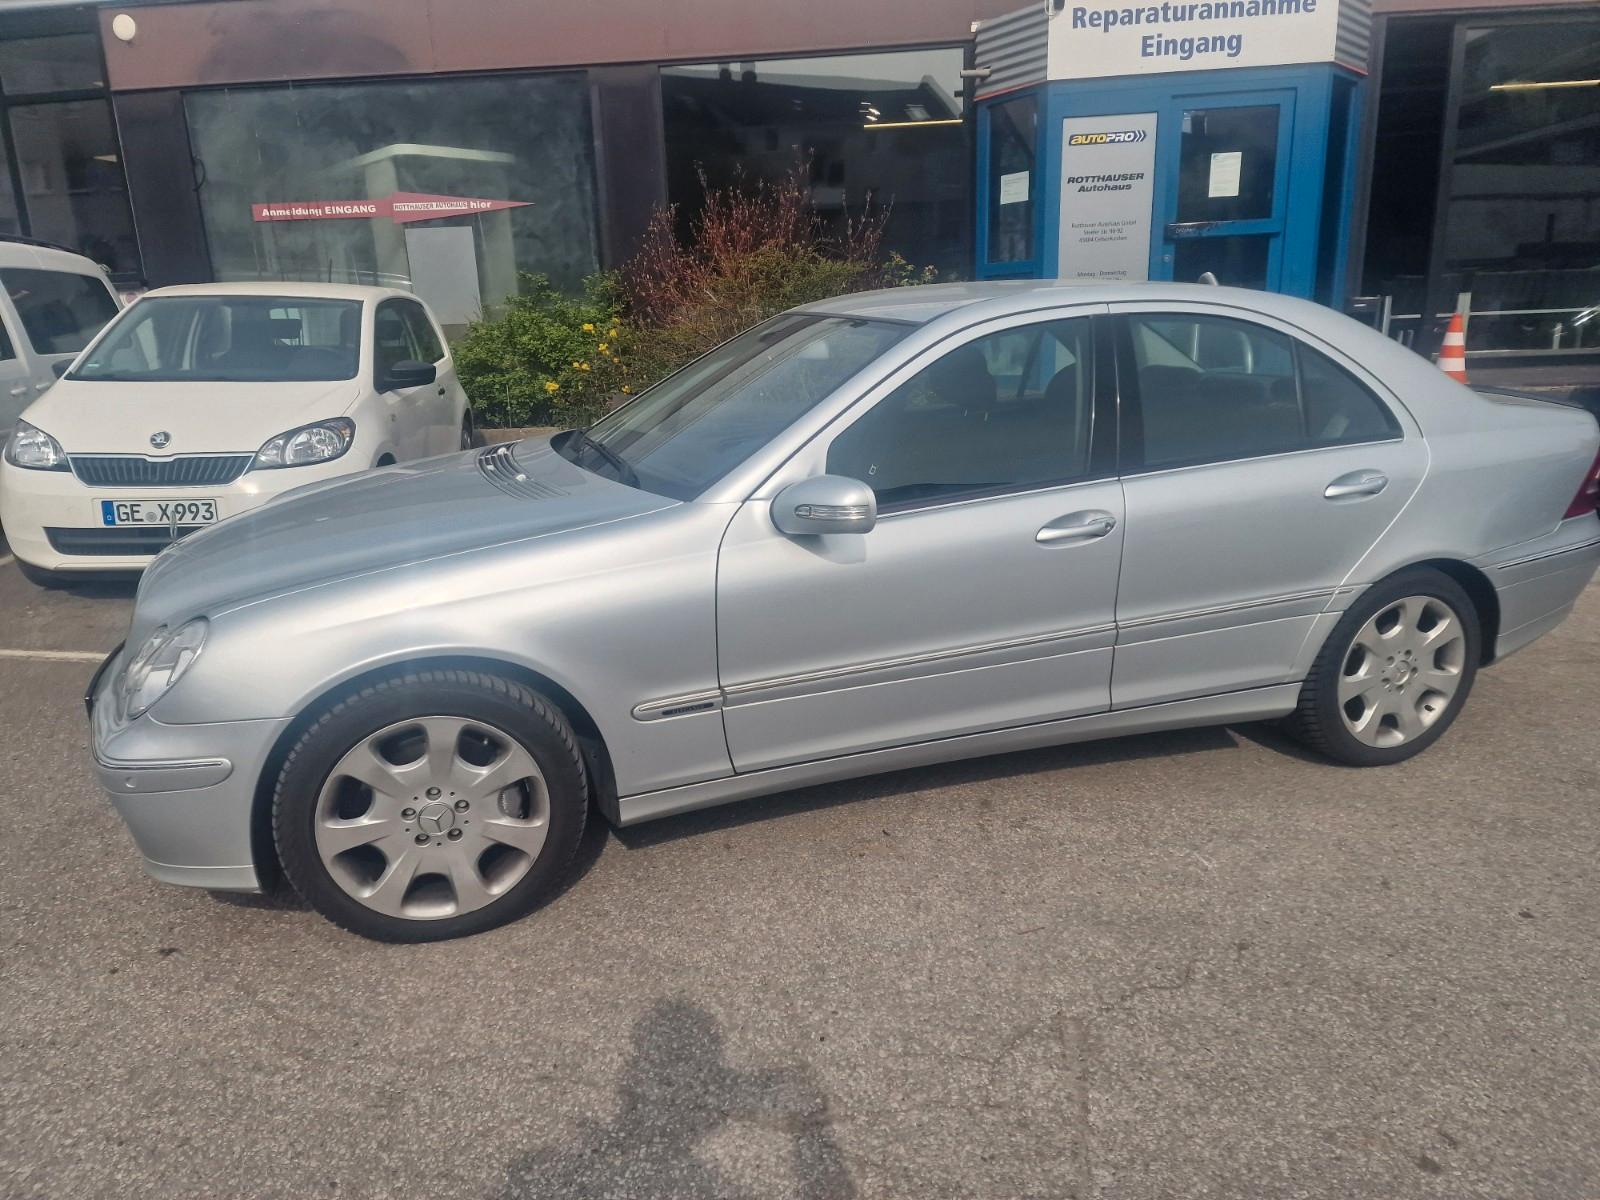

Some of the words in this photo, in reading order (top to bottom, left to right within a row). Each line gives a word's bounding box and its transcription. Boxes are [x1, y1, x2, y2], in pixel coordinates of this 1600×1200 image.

[1072, 0, 1317, 33] Reparaturannahme
[1141, 33, 1243, 61] Eingang
[1067, 172, 1145, 185] ROTTHAUSER
[1078, 183, 1132, 193] Autohaus
[324, 204, 377, 215] EINGANG
[116, 503, 144, 522] GE
